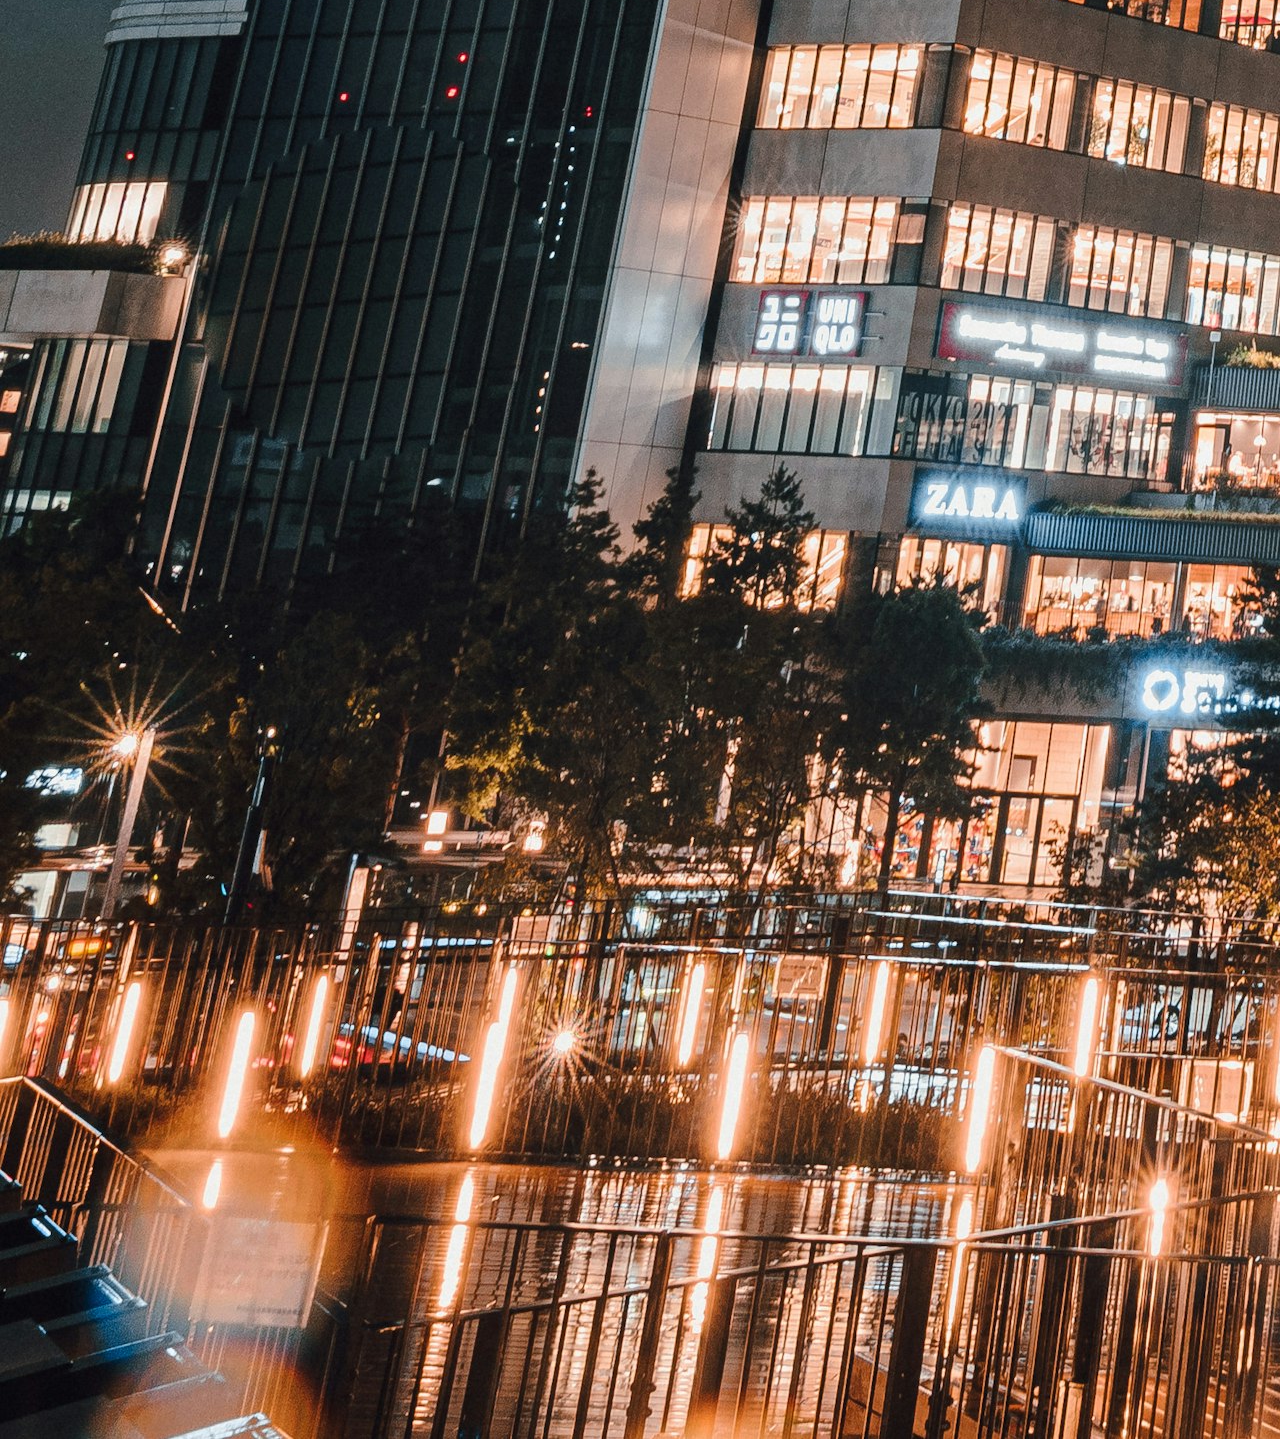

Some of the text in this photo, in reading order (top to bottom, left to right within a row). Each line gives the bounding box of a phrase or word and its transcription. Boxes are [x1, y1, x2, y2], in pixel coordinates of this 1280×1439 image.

[761, 296, 801, 323] ユニ
[819, 297, 858, 324] UNI
[754, 323, 797, 351] クロ
[814, 324, 855, 356] QLO
[923, 483, 1020, 521] ZARA
